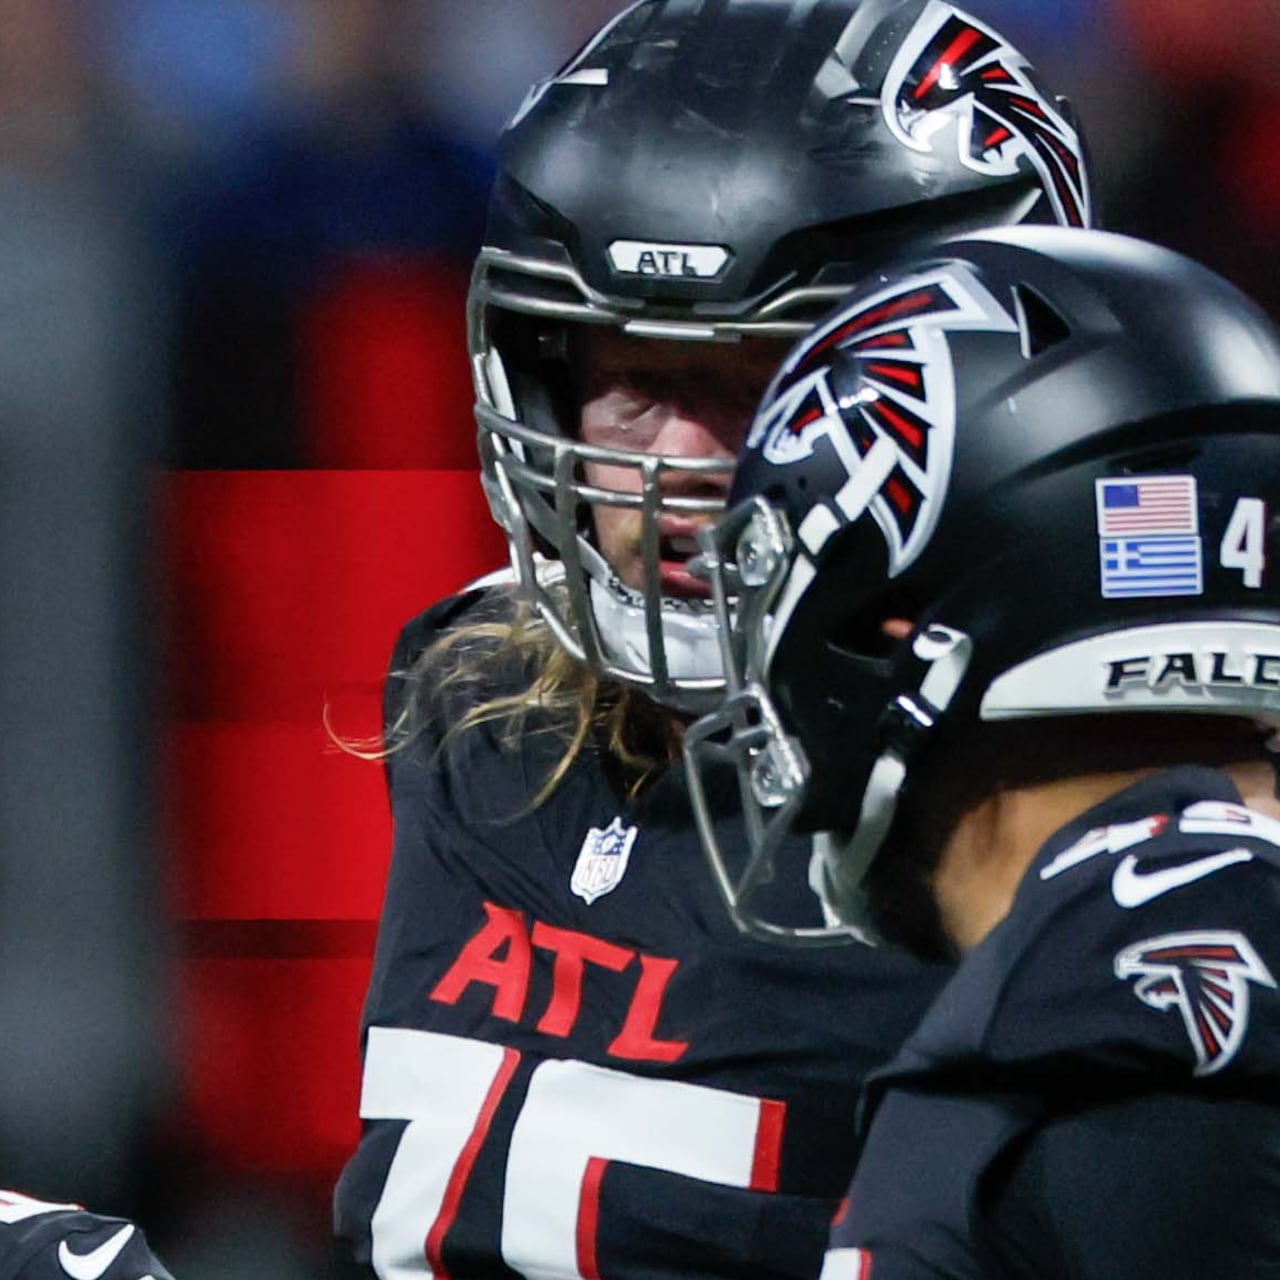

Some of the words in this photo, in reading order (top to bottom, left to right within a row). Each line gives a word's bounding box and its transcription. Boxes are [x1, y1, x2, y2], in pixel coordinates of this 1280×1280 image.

[638, 250, 697, 277] ATL
[1219, 497, 1266, 589] 4
[429, 900, 691, 1062] ATL
